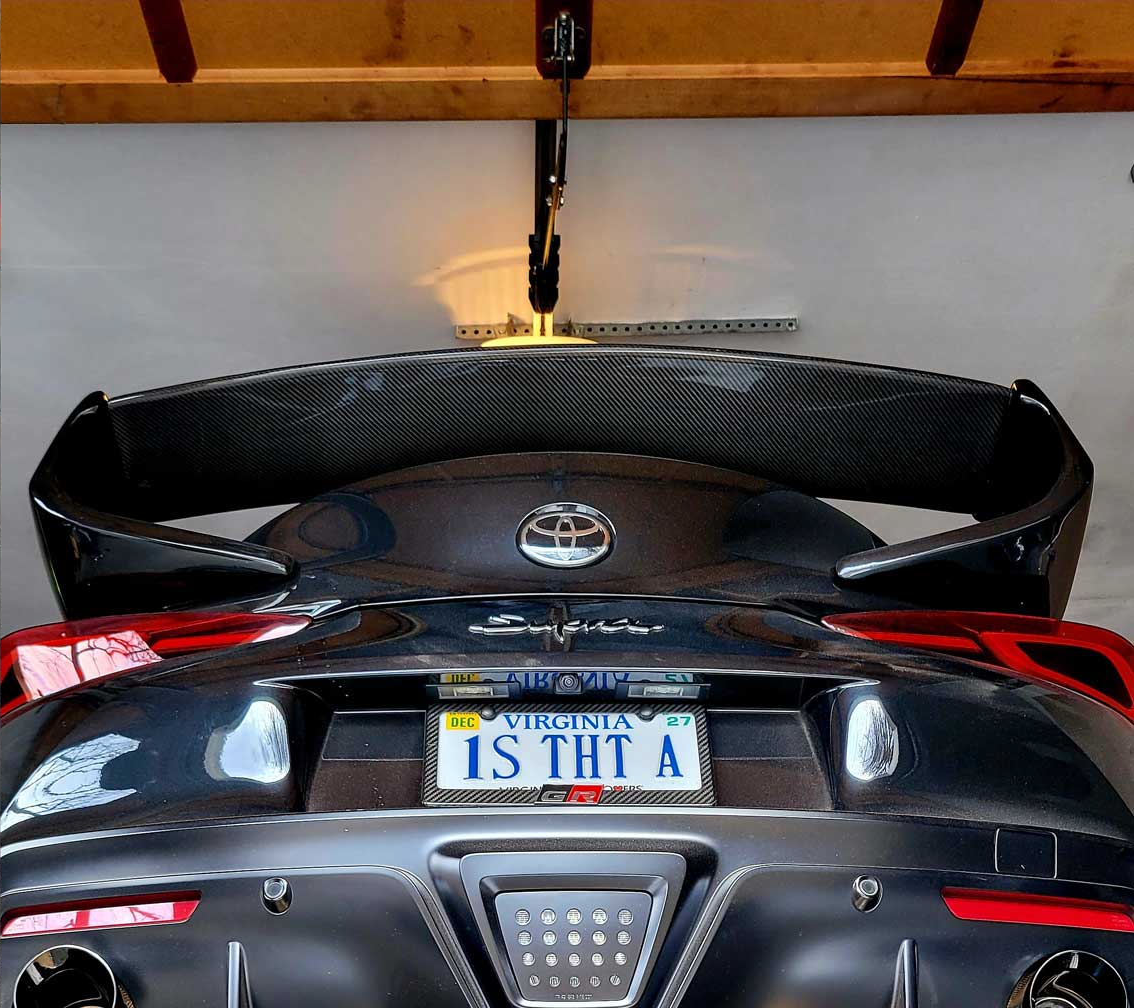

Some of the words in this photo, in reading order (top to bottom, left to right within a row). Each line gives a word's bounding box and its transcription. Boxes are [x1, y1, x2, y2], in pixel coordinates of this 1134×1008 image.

[468, 613, 665, 644] Supra
[450, 716, 475, 728] DEC
[503, 714, 634, 730] VIRGINIA
[666, 716, 691, 727] 27
[463, 734, 520, 780] 1S
[541, 734, 633, 780] THT
[656, 734, 684, 778] A
